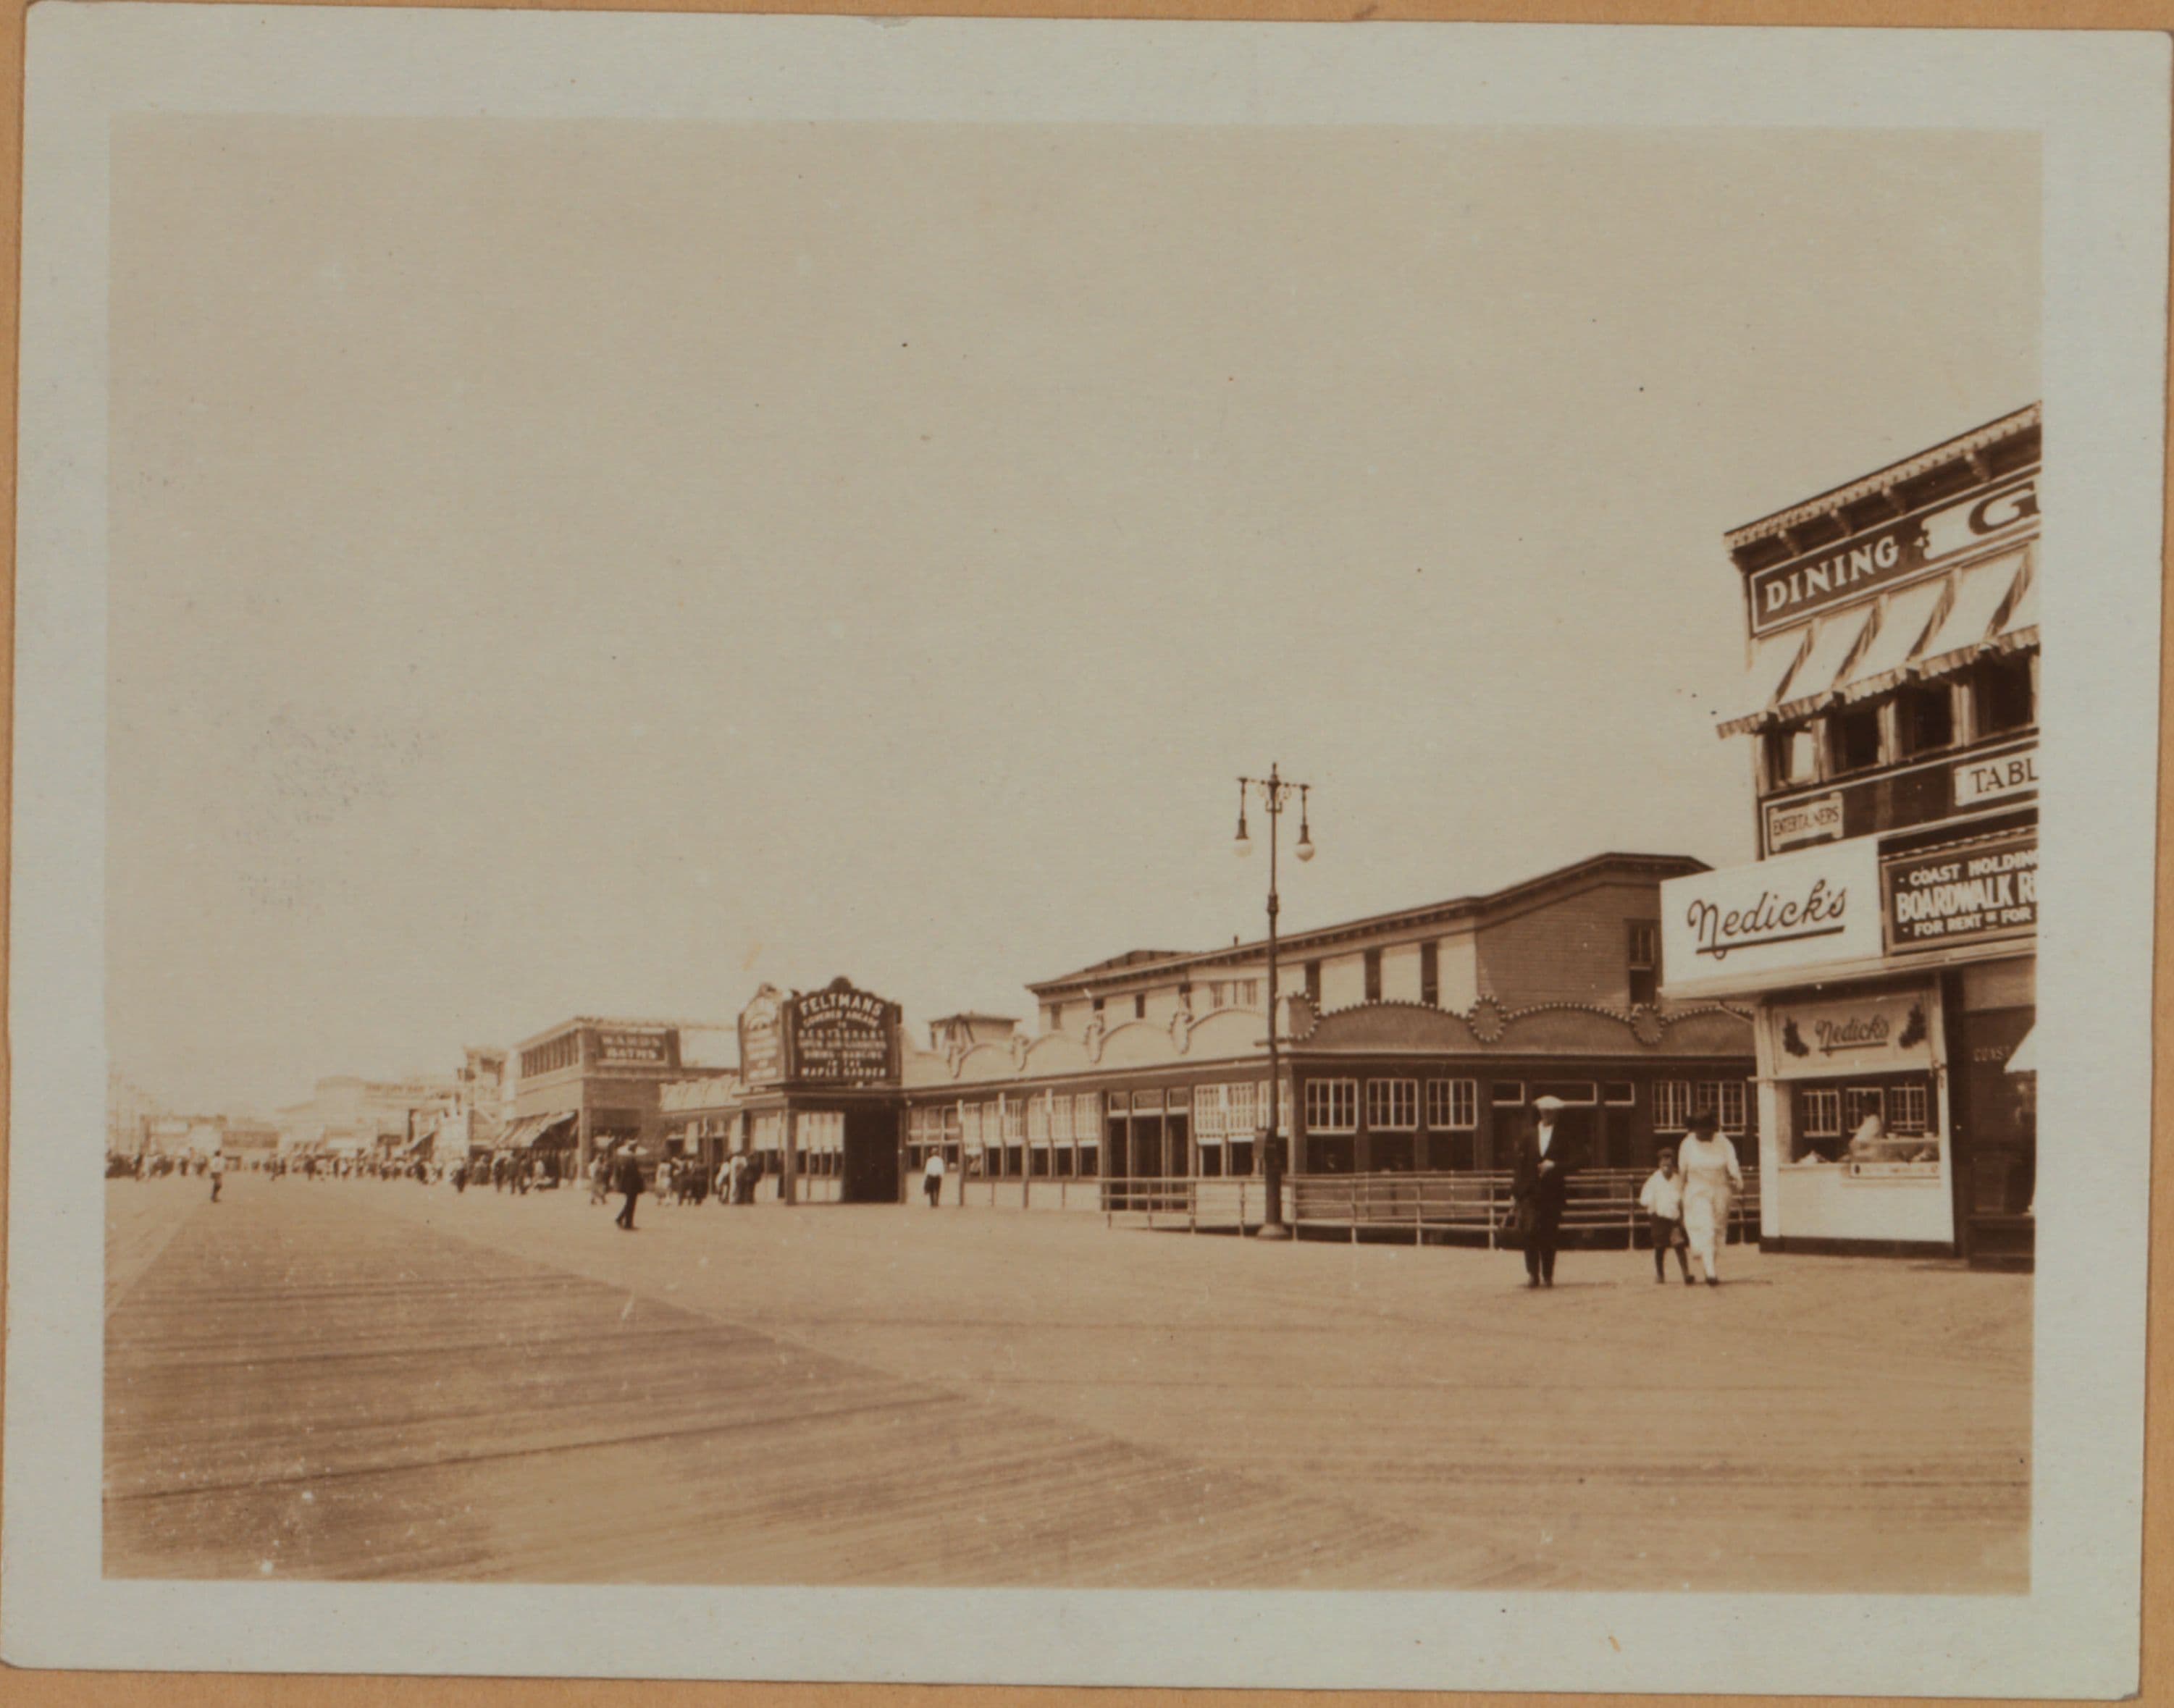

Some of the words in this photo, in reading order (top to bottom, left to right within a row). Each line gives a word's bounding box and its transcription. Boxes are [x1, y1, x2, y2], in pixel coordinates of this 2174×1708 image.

[1766, 535, 1900, 613] DINING
[1971, 757, 2039, 793] TABL
[1773, 806, 1839, 836] ENTERTANERS
[1909, 862, 1961, 886] COAST
[1968, 849, 2038, 877] HOLDIN
[1896, 874, 2014, 922] BOARDWALK
[1687, 879, 1846, 959] Nedick's
[1914, 920, 1944, 936] FOR
[1947, 913, 1982, 932] RENT
[2000, 907, 2031, 924] FOR
[799, 993, 884, 1017] FELTMANS
[801, 1067, 838, 1077] MAPLE
[843, 1067, 886, 1077] GARDEN
